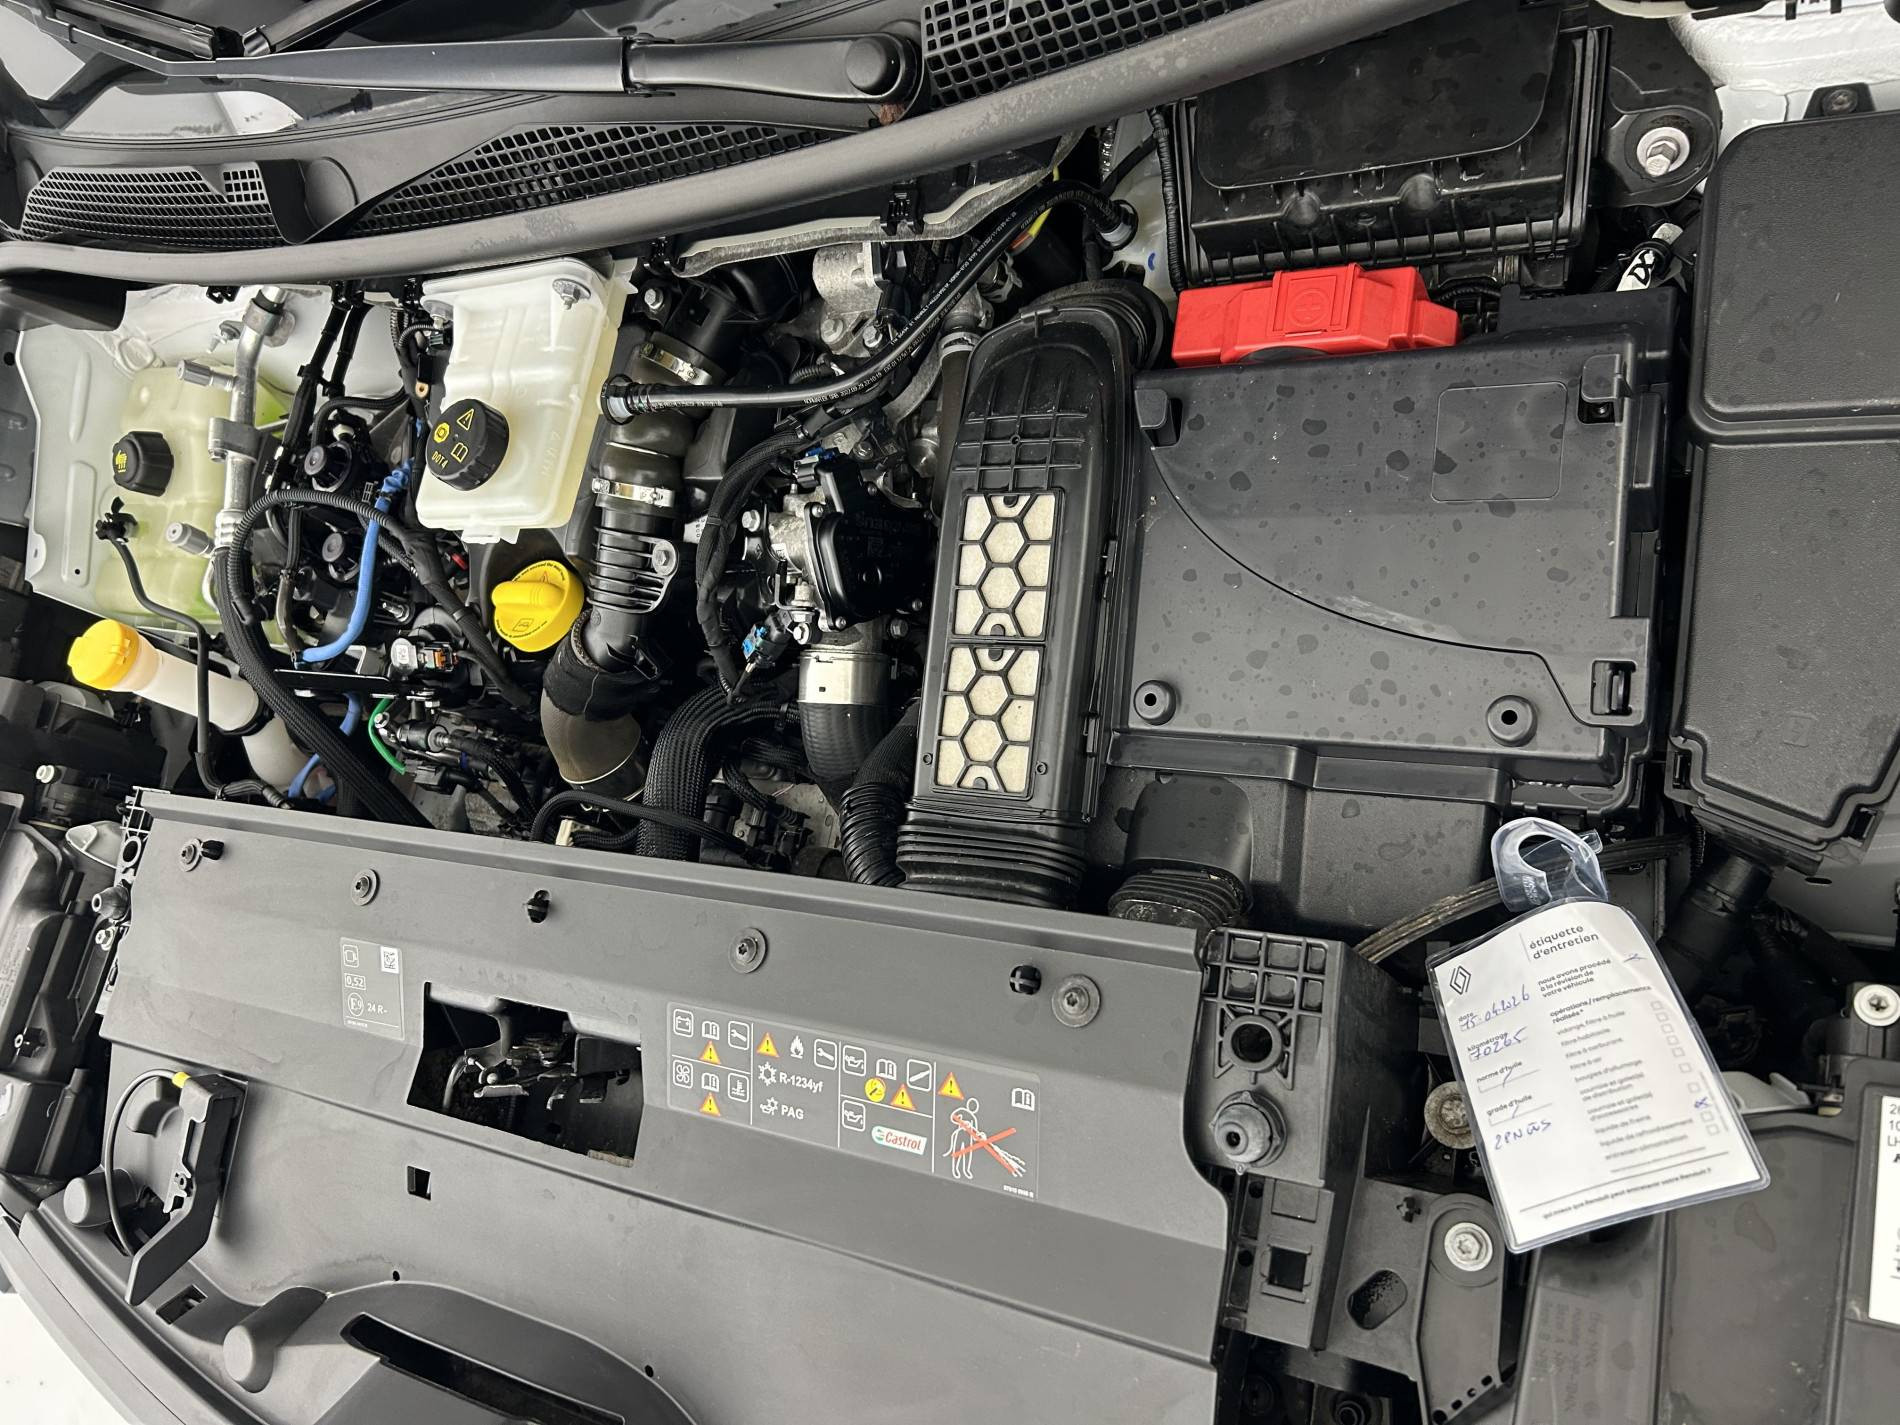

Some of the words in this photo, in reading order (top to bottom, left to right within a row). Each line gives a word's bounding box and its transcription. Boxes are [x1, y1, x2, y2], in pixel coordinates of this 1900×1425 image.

[1529, 925, 1584, 950] étiquette
[1533, 933, 1599, 959] d'entretien
[1538, 976, 1556, 986] nous
[1556, 968, 1579, 979] avons
[1580, 958, 1611, 972] procédé
[1547, 982, 1553, 990] la
[1554, 973, 1583, 987] révision
[1584, 970, 1594, 978] de
[1542, 988, 1562, 998] votre
[1563, 977, 1595, 991] véhicule
[367, 1003, 376, 1012] 24
[780, 1072, 824, 1093] R-1234yf
[781, 1105, 804, 1120] PAG
[885, 1131, 922, 1151] Castrol
